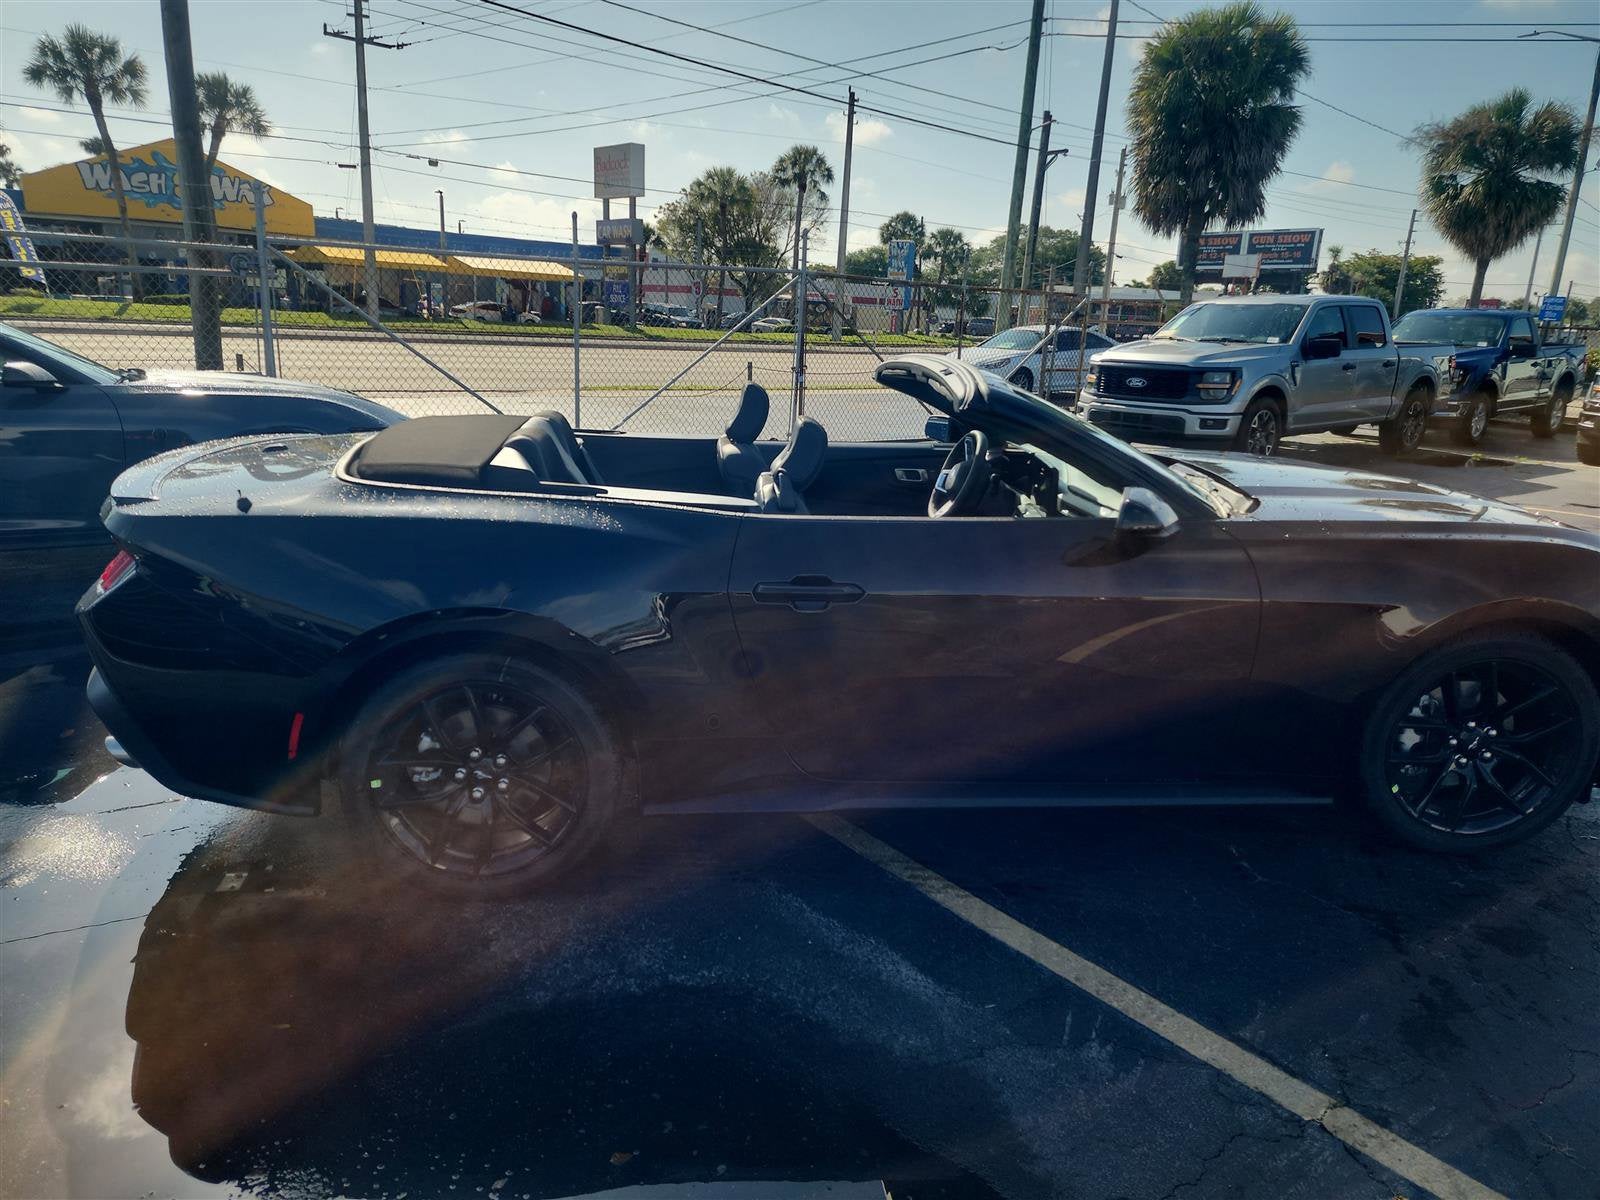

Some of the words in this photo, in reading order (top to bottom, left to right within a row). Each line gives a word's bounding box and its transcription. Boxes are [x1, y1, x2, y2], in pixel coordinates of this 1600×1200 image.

[76, 161, 166, 195] WASH
[598, 225, 612, 239] CAR
[613, 223, 632, 238] WASH
[1208, 236, 1239, 245] SHOW
[1252, 235, 1275, 244] GUN
[1278, 233, 1312, 243] SHOW
